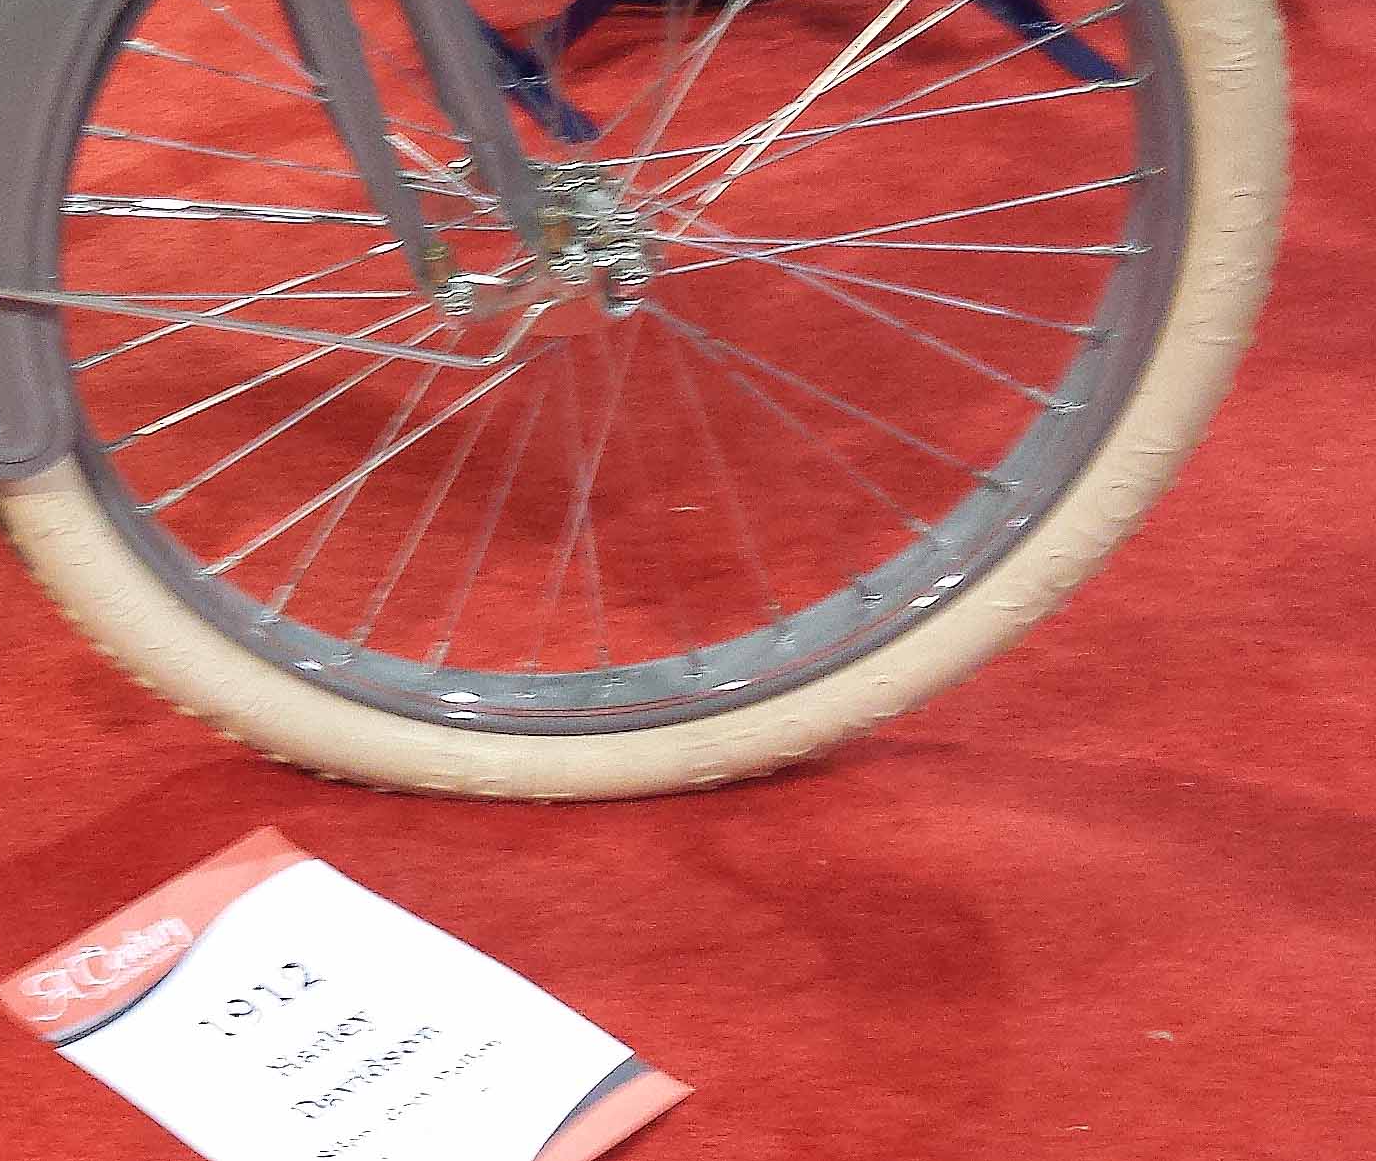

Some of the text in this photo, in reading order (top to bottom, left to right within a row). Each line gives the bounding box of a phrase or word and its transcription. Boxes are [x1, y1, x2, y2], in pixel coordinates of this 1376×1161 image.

[198, 962, 328, 1037] 1912
[265, 1009, 377, 1077] Harley
[289, 1025, 444, 1120] Davidson
